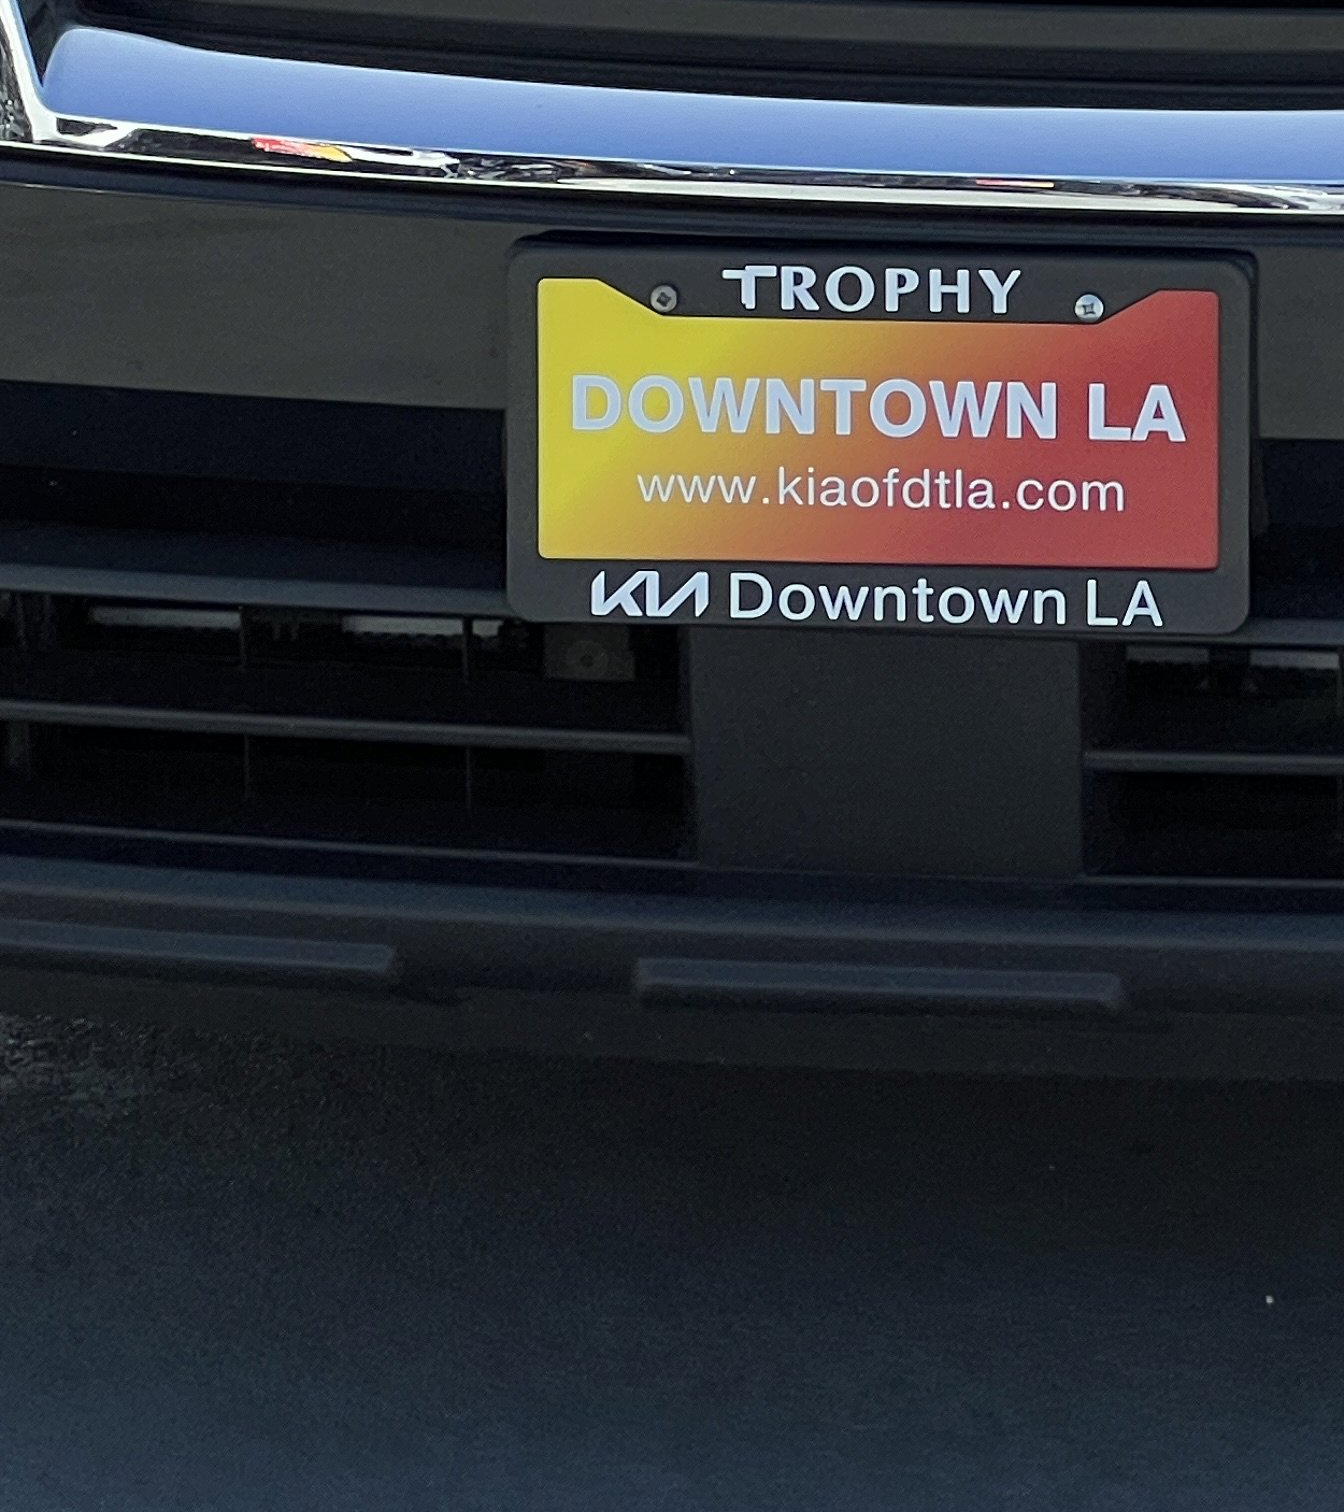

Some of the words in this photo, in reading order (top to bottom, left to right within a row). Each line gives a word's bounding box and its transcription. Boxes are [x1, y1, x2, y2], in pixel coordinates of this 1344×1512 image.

[722, 264, 1022, 314] TROPHY
[571, 374, 1057, 440] DOWNTOWN
[1087, 382, 1187, 442] LA
[637, 467, 1125, 512] www.kiaofdtla.com
[729, 571, 1068, 625] Downtown
[1086, 578, 1164, 628] LA
